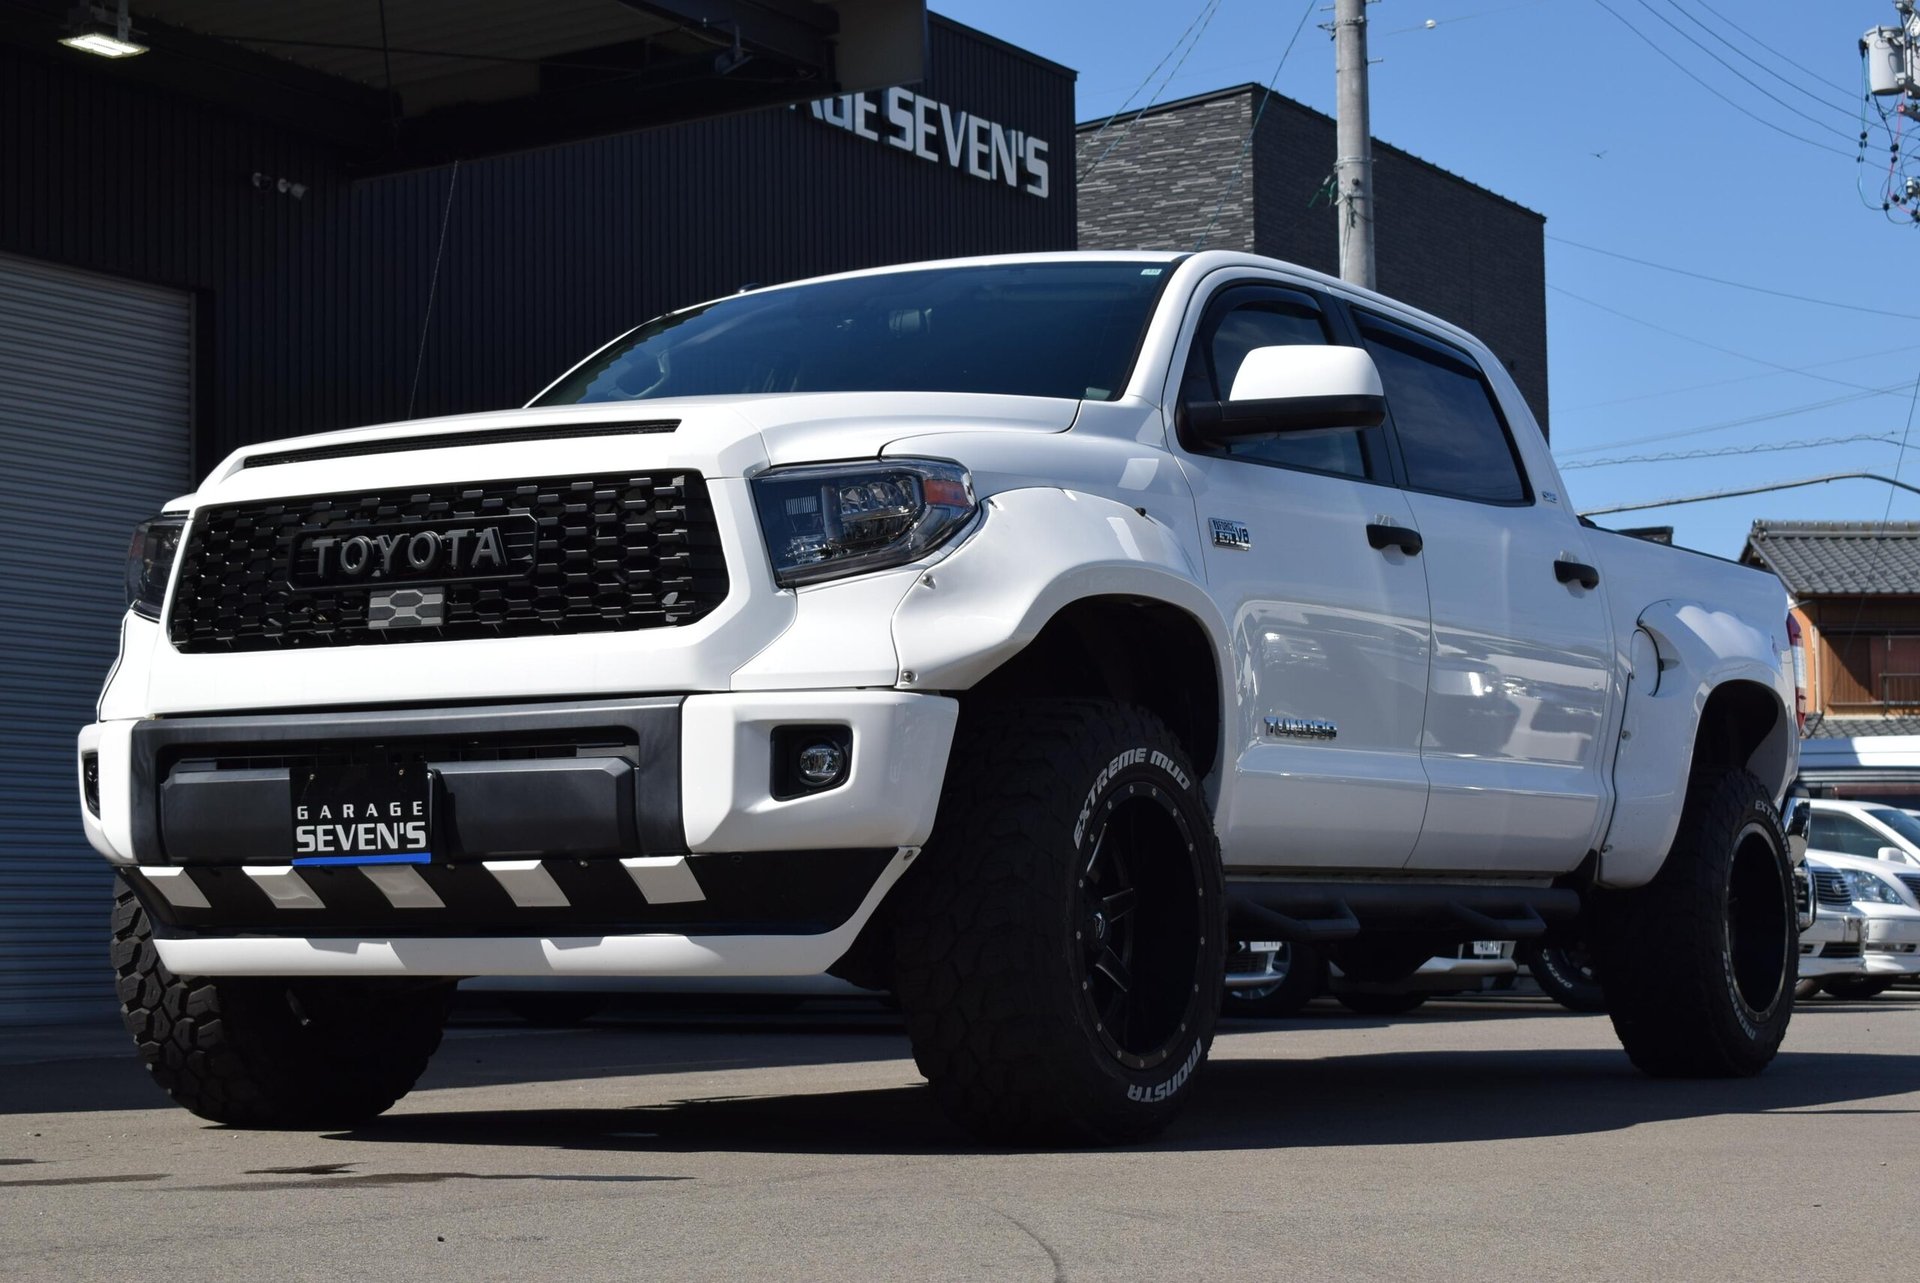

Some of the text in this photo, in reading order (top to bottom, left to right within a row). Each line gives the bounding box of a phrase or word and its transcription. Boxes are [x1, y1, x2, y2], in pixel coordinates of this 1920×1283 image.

[887, 86, 1049, 198] SEVEN'S
[312, 527, 507, 579] TOYOTA
[1235, 527, 1250, 544] V8
[297, 801, 423, 820] GARAGE
[1073, 748, 1191, 850] EXTREME MUD
[296, 821, 427, 852] SEVEN'S
[1127, 1036, 1202, 1103] MONSTA
